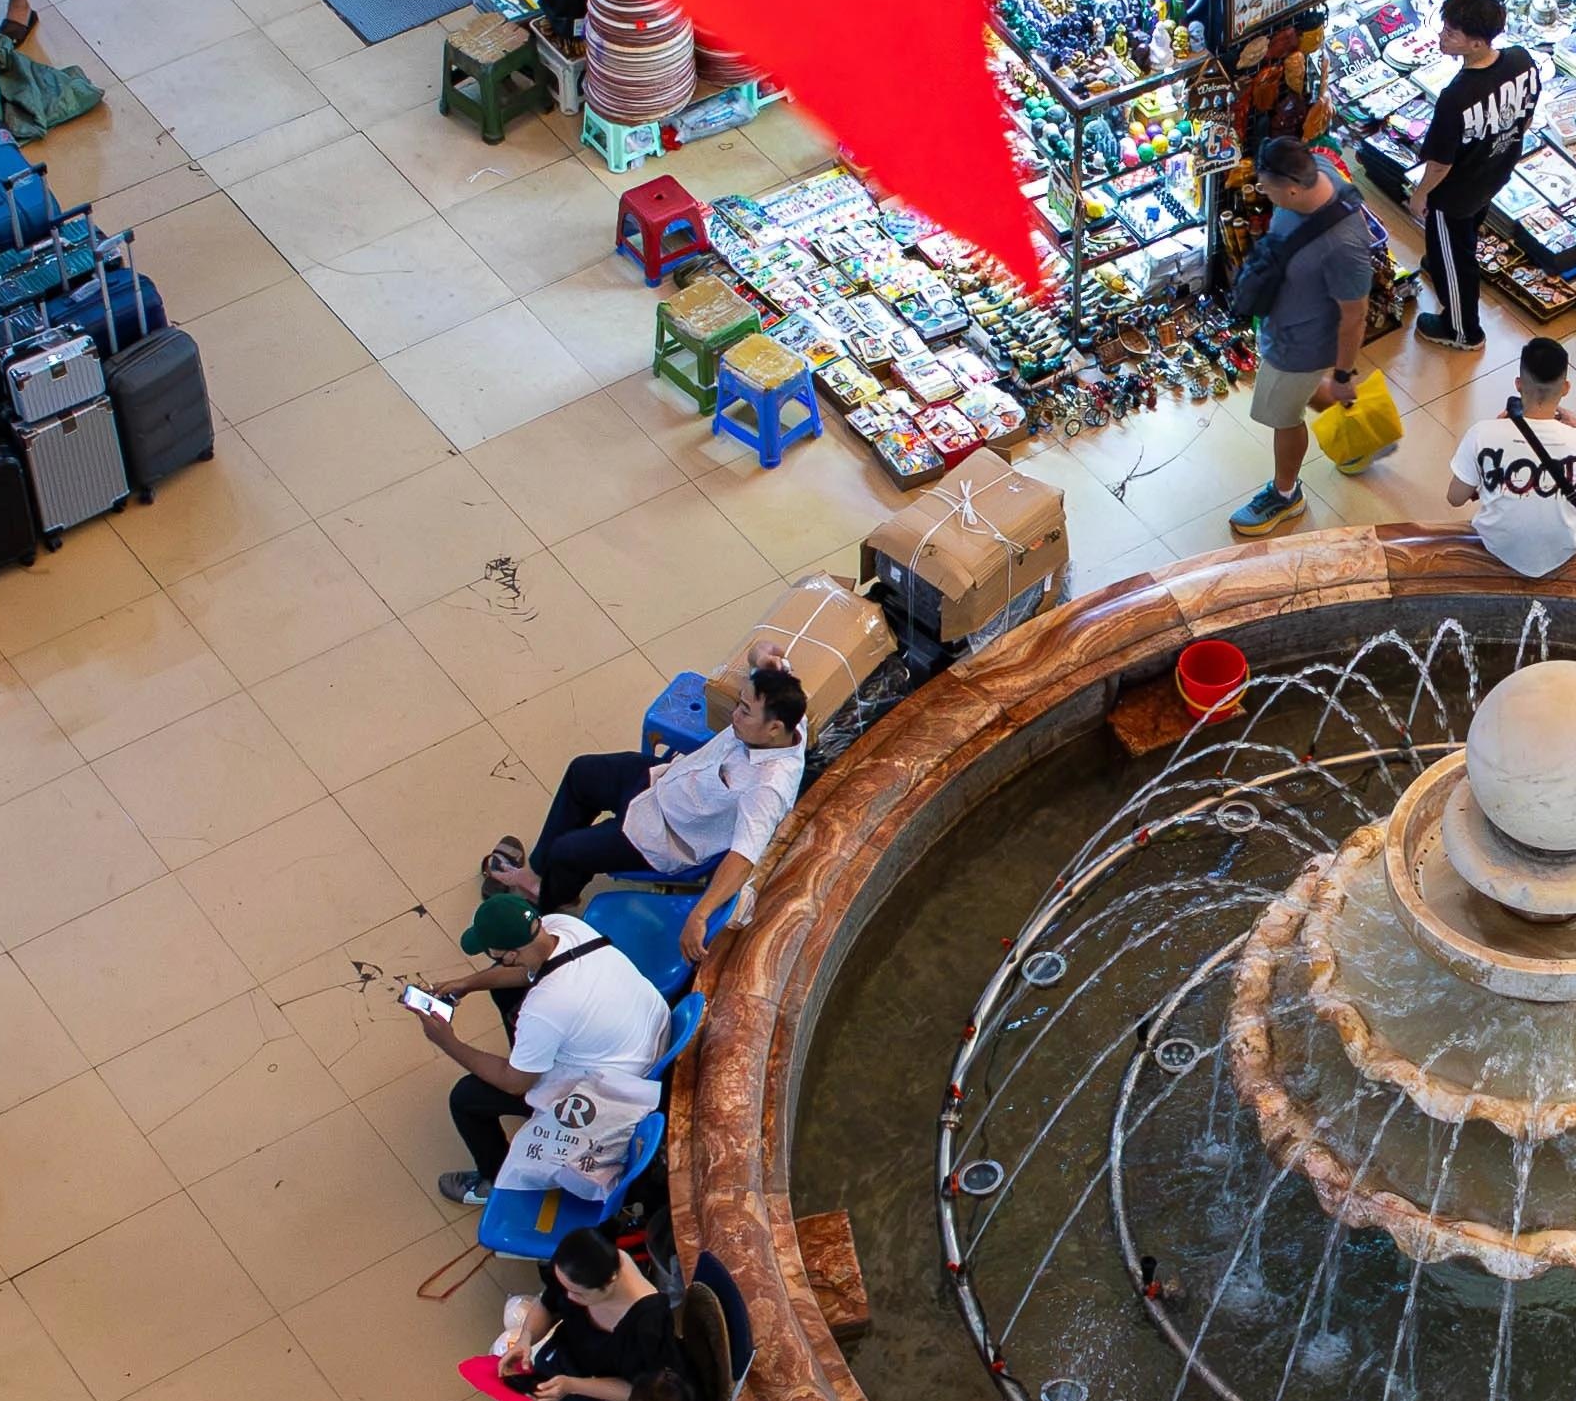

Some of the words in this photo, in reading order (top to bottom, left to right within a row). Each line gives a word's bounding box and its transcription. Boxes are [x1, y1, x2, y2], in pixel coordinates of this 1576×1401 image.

[1379, 35, 1387, 46] no
[1388, 23, 1416, 41] smoking
[1355, 71, 1378, 87] WC
[533, 1125, 550, 1139] Ou
[555, 1130, 580, 1145] Lan
